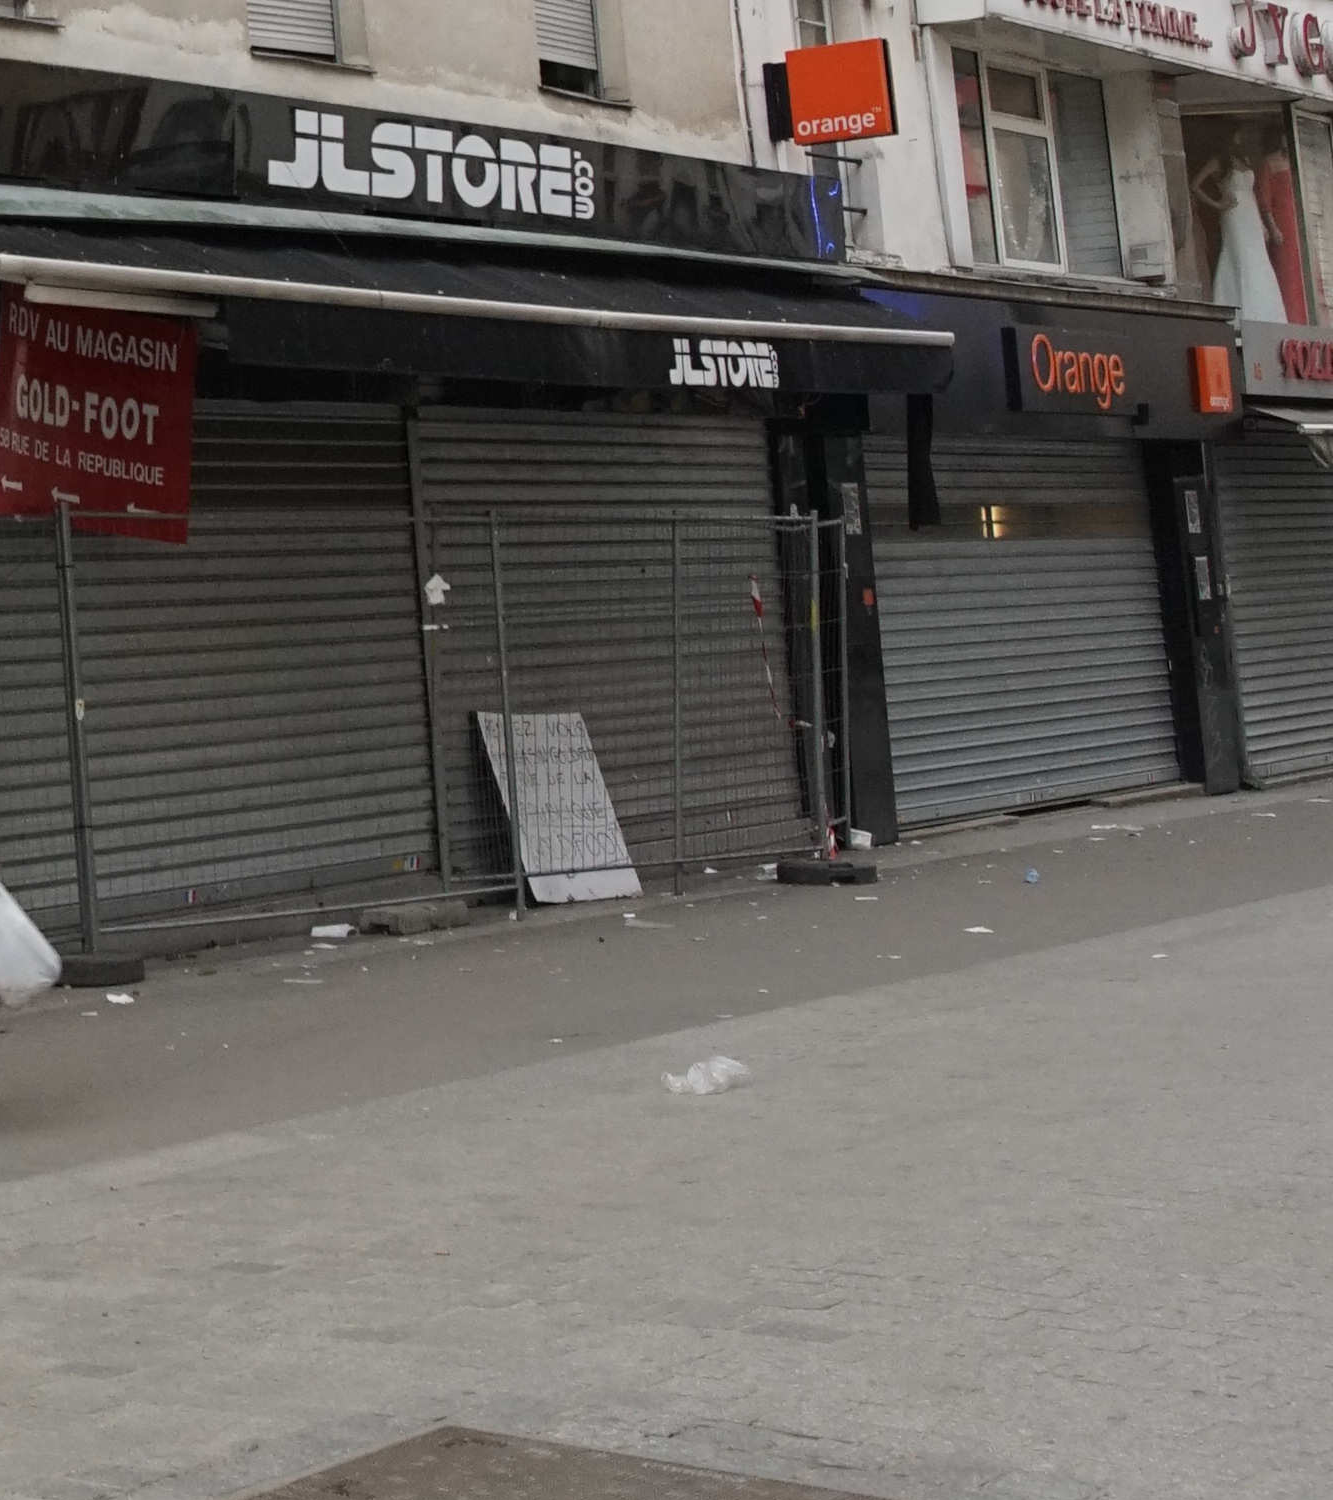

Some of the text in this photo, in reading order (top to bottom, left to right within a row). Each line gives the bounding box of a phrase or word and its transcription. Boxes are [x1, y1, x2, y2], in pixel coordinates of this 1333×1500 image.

[797, 112, 876, 136] orange
[268, 108, 573, 218] JLSTORE
[9, 303, 178, 372] RDV AU MAGASIN
[669, 338, 773, 388] JLSTORE
[1032, 334, 1126, 409] Orange
[16, 374, 159, 445] GOLD-FOOT
[11, 432, 30, 456] RUE
[34, 441, 49, 463] DE
[55, 449, 72, 469] LA
[77, 451, 165, 486] REPUBLIQUE
